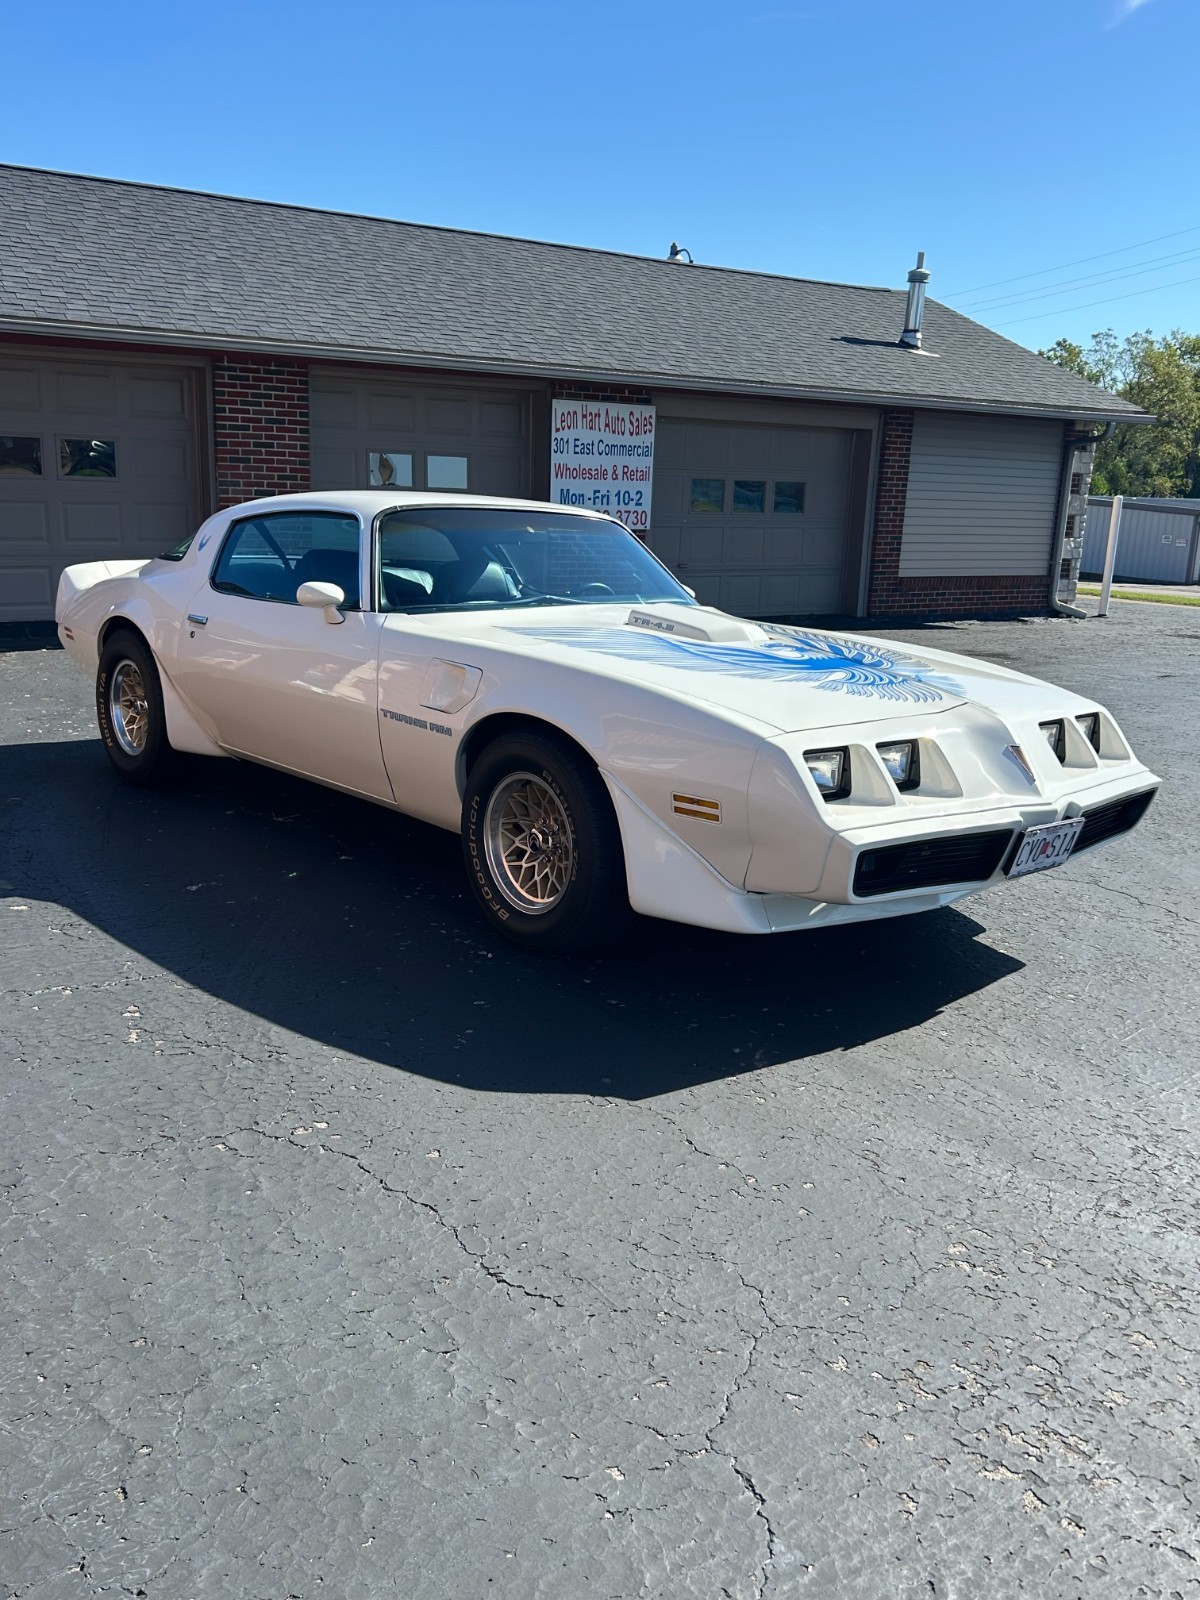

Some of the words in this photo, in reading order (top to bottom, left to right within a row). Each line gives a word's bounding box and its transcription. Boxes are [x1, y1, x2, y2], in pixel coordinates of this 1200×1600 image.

[555, 407, 578, 433] Leon
[582, 404, 601, 432] Hart
[604, 407, 626, 436] Auto
[628, 410, 653, 437] Sales
[553, 437, 570, 455] 301
[573, 438, 595, 456] East
[597, 439, 653, 458] Commercial
[554, 462, 608, 481] Wholesale
[611, 464, 619, 481] &
[622, 465, 651, 482] Retail
[614, 490, 643, 507] 10-2
[380, 708, 428, 730] TRANS
[429, 721, 453, 737] AM
[468, 794, 511, 921] BFGoodrich
